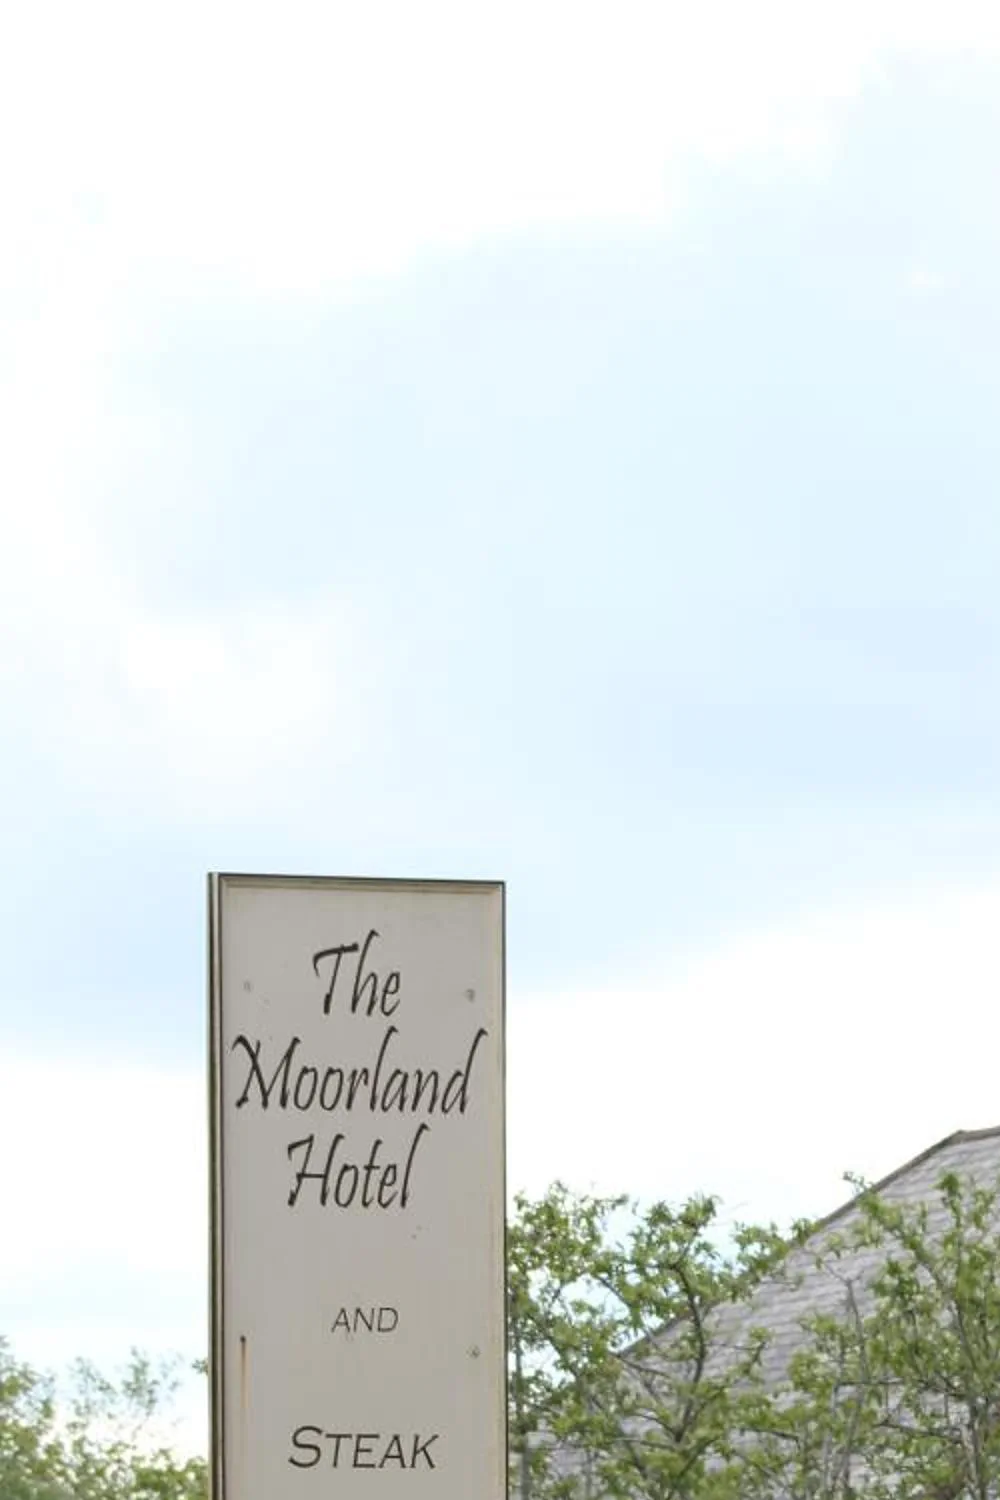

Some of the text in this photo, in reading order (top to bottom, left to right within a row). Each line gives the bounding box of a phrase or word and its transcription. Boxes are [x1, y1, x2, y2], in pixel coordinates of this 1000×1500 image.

[313, 928, 402, 1016] The
[231, 1025, 488, 1114] Moorland
[287, 1122, 430, 1209] Hotel
[331, 1307, 399, 1333] AND
[288, 1425, 440, 1469] STEAK
